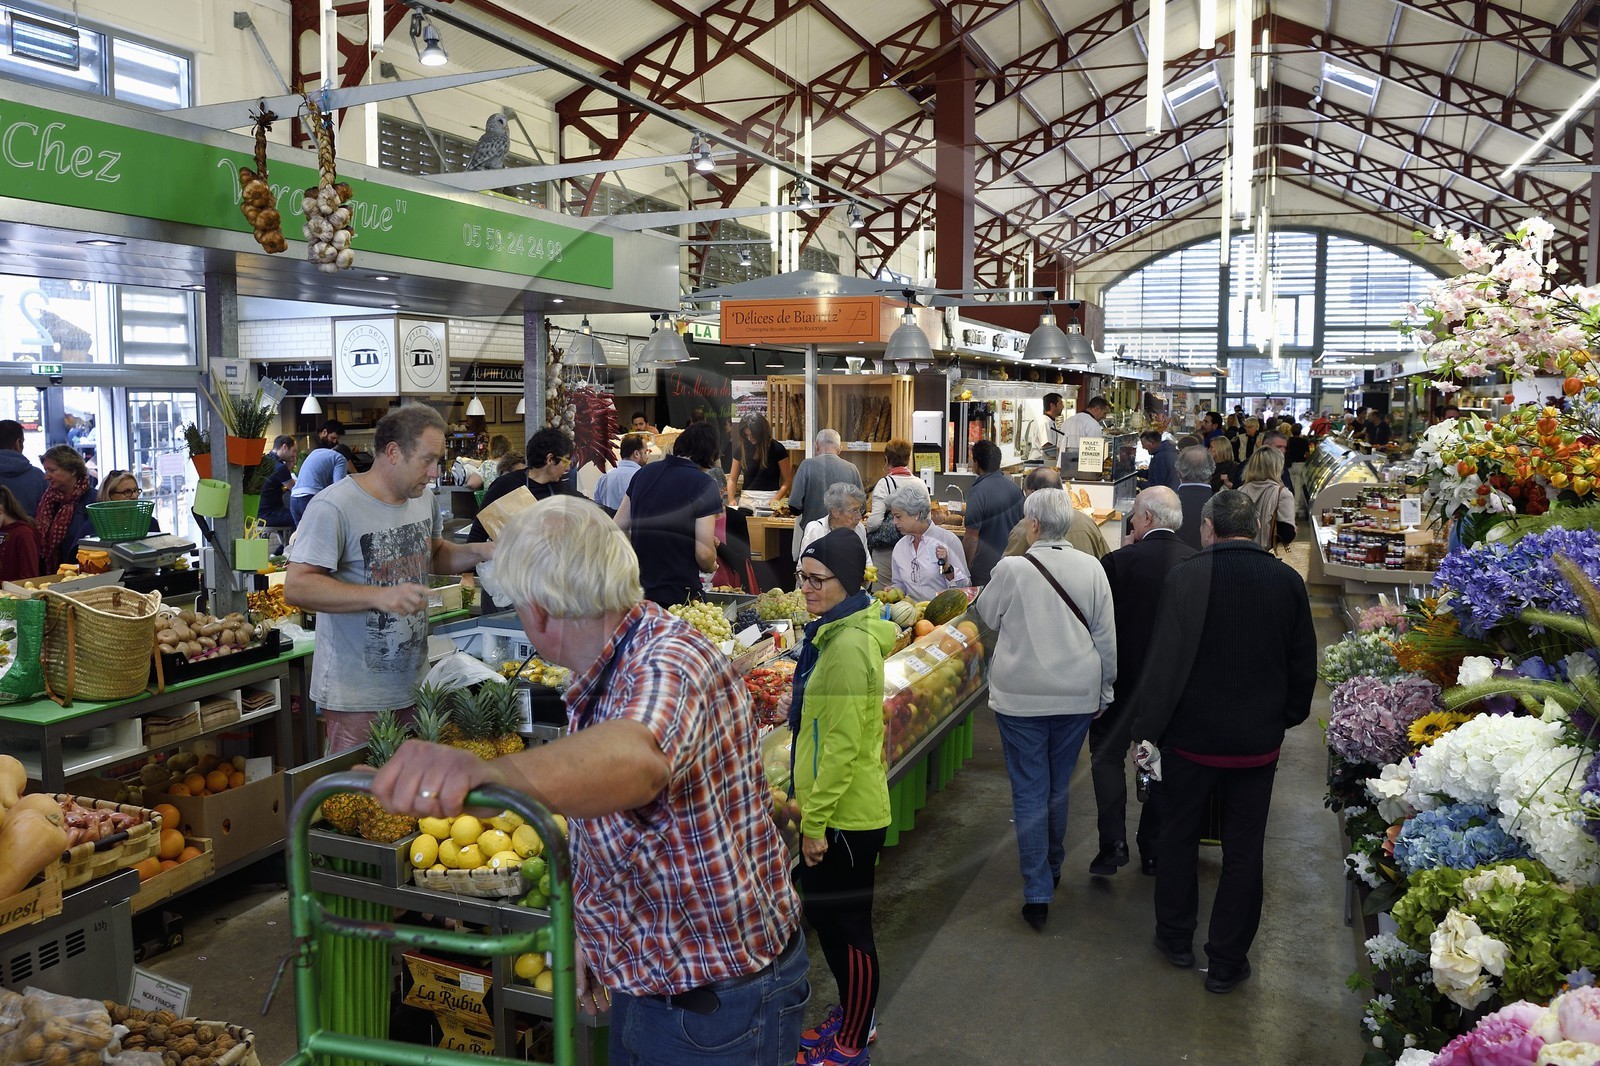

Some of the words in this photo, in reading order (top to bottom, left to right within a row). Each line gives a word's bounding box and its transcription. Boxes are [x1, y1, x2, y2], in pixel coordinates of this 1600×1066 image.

[462, 223, 481, 248] 05
[486, 227, 503, 252] 59
[507, 231, 525, 256] 24
[528, 236, 544, 260] 24
[777, 309, 791, 324] de
[694, 324, 712, 339] LA
[415, 984, 436, 1002] La
[439, 990, 483, 1015] Rubia
